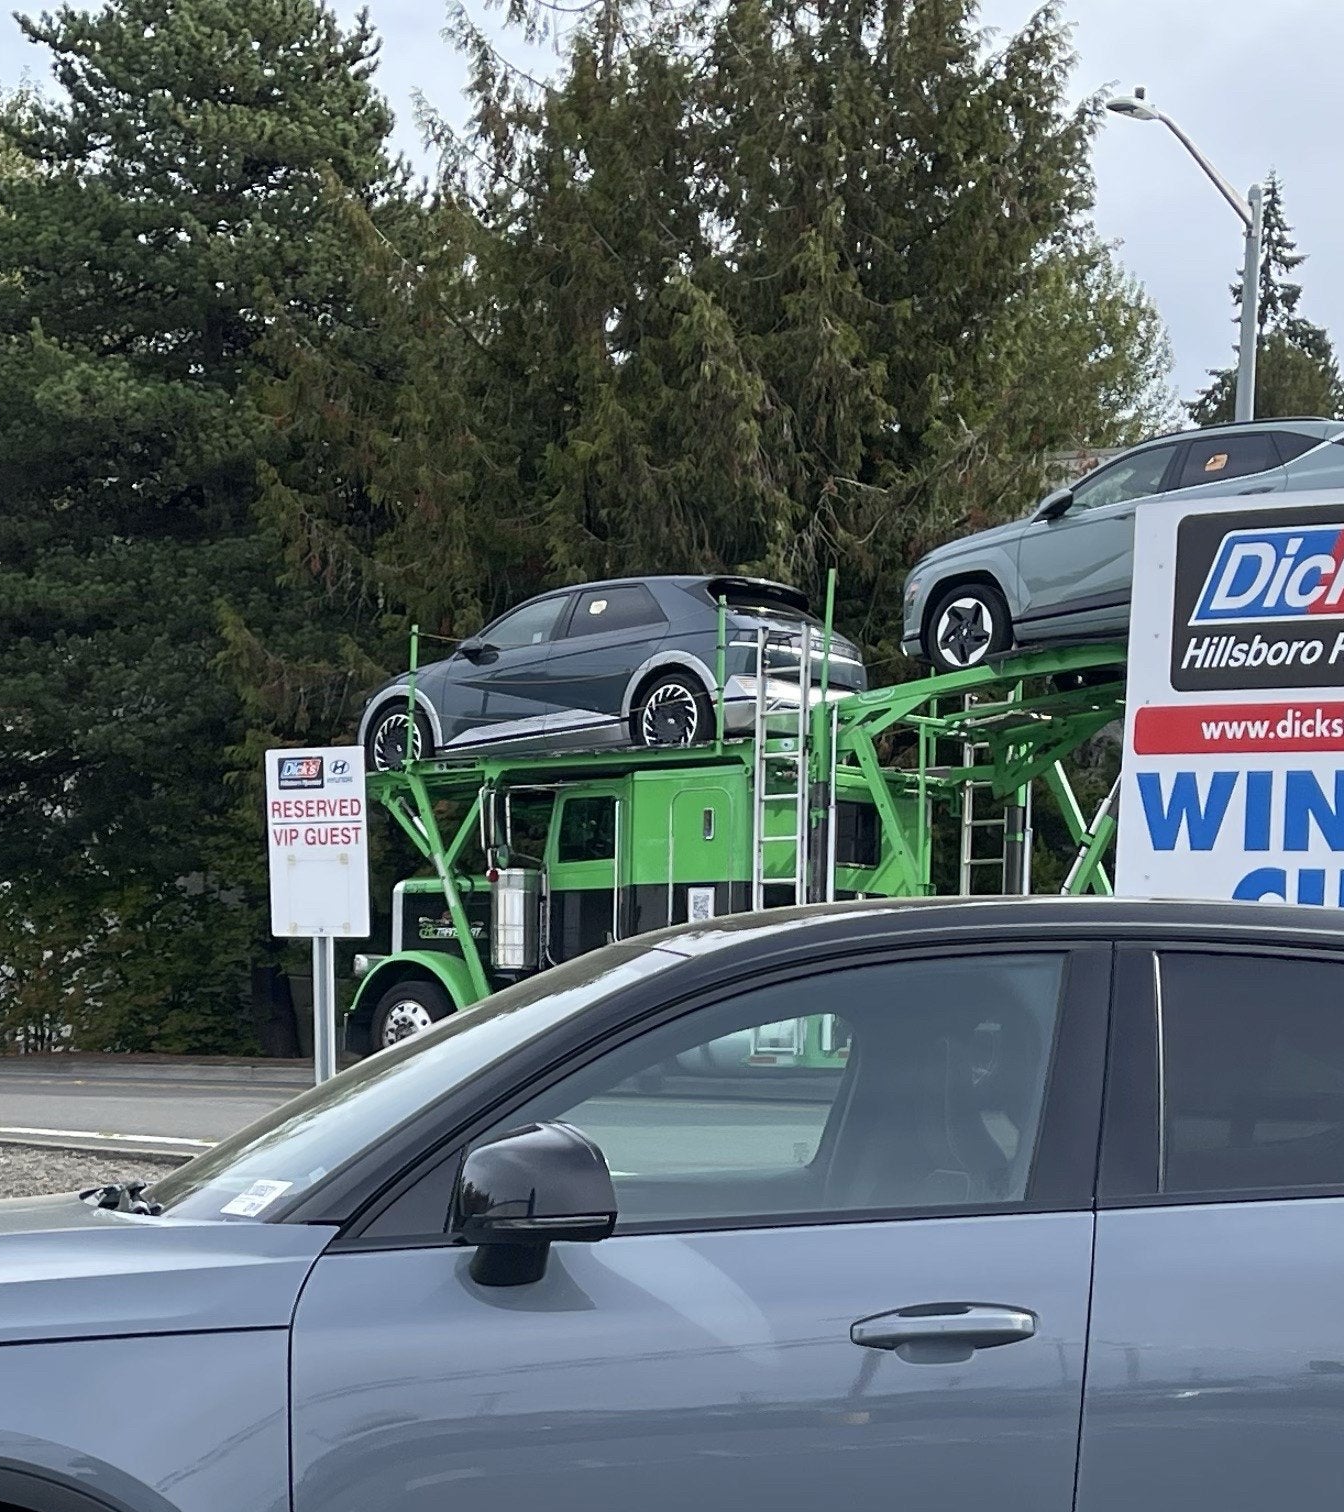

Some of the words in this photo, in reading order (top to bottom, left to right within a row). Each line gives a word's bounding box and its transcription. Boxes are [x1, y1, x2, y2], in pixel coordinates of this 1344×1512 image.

[1181, 633, 1323, 669] Hillsboro
[271, 799, 362, 819] RESERVED
[273, 828, 299, 846] VIP
[305, 827, 362, 846] GUEST
